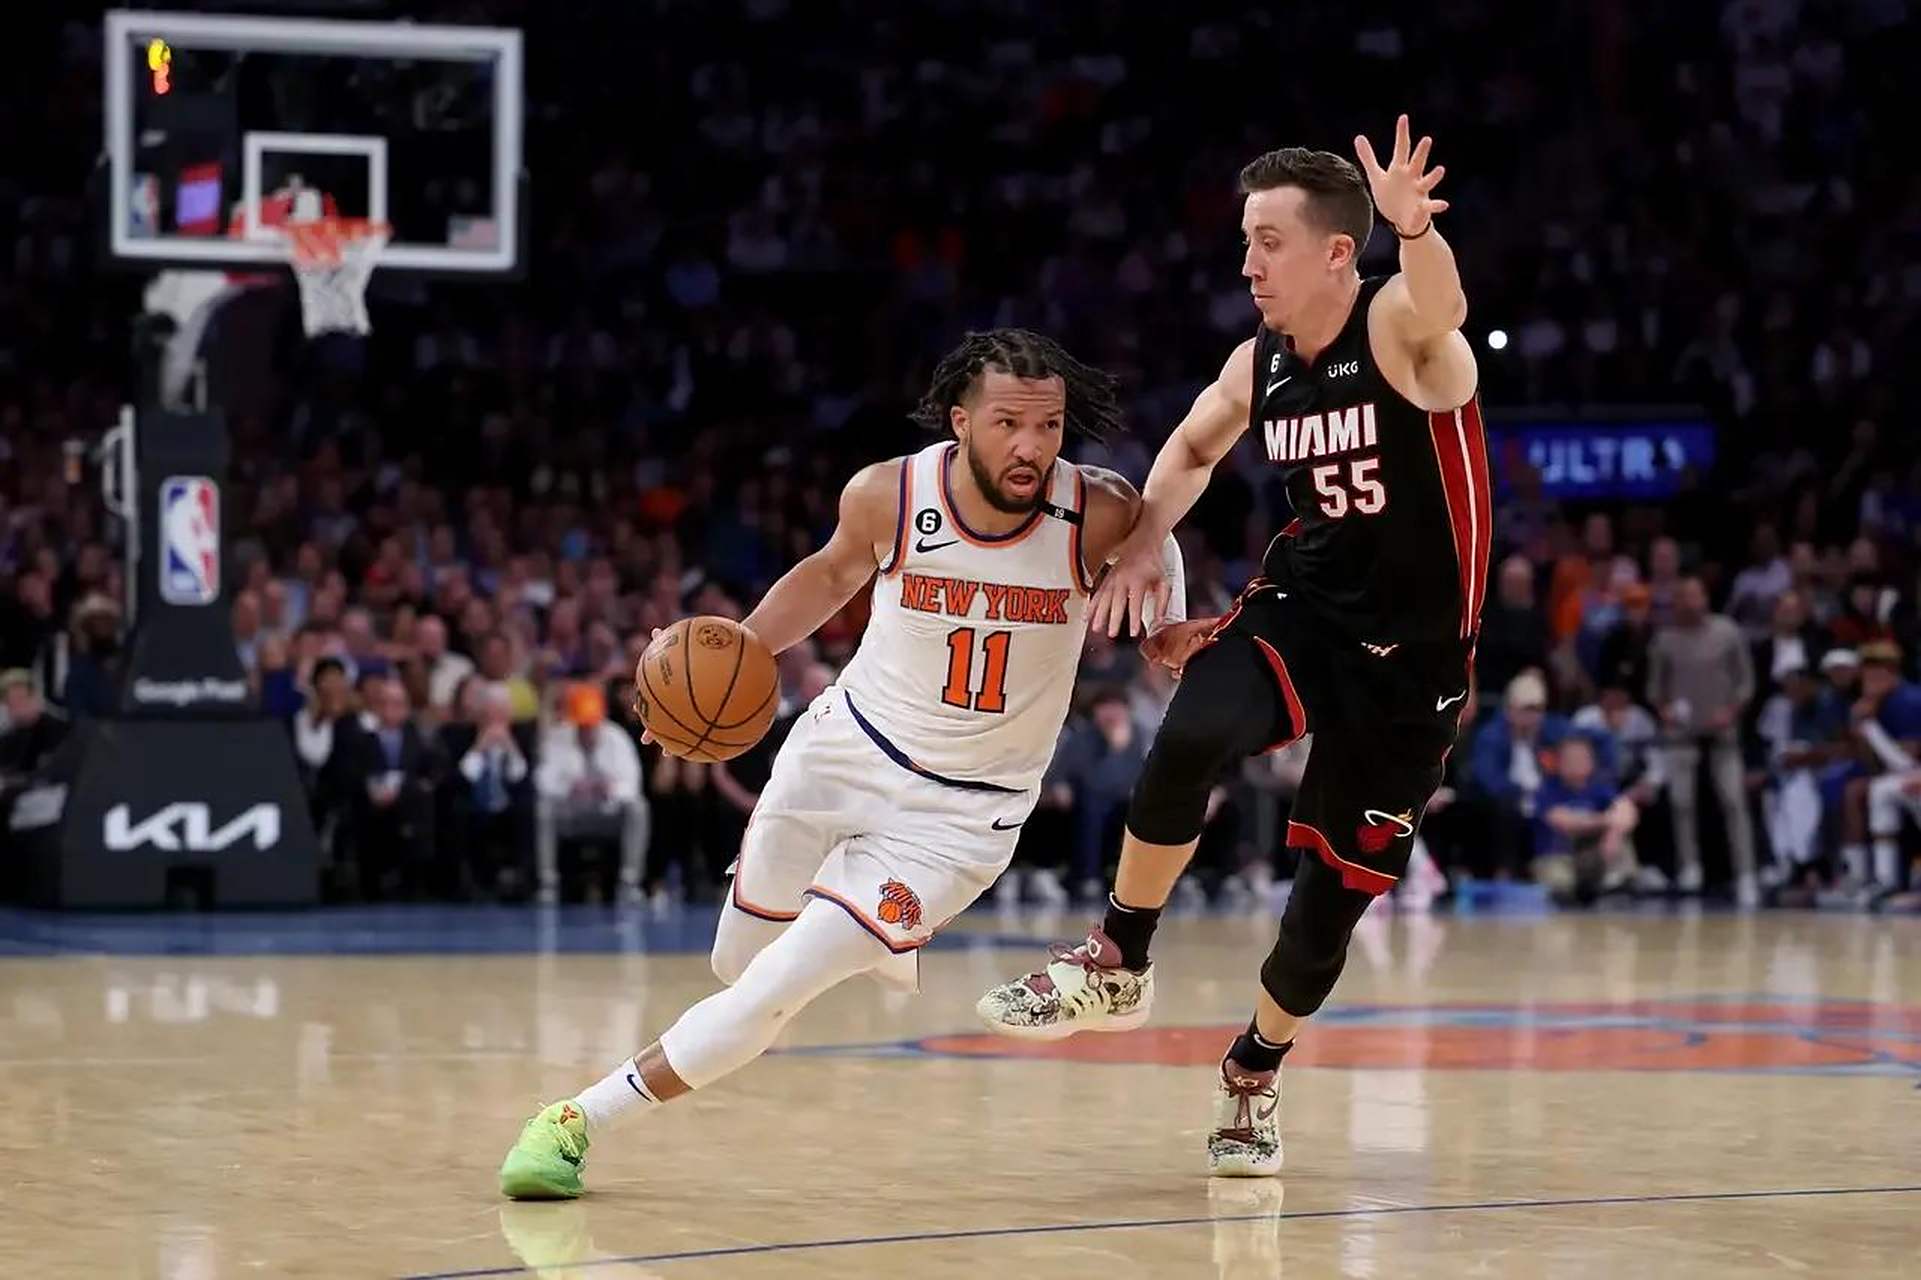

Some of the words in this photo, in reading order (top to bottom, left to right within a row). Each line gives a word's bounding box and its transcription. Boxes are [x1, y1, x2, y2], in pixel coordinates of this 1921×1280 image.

[1271, 354, 1280, 373] 6
[1263, 403, 1377, 461] MIAMI
[1313, 458, 1386, 518] 55
[920, 511, 936, 532] 6
[900, 574, 978, 616] NEW
[980, 583, 1070, 624] YORK
[942, 627, 1011, 713] 11
[104, 802, 281, 851] KIA
